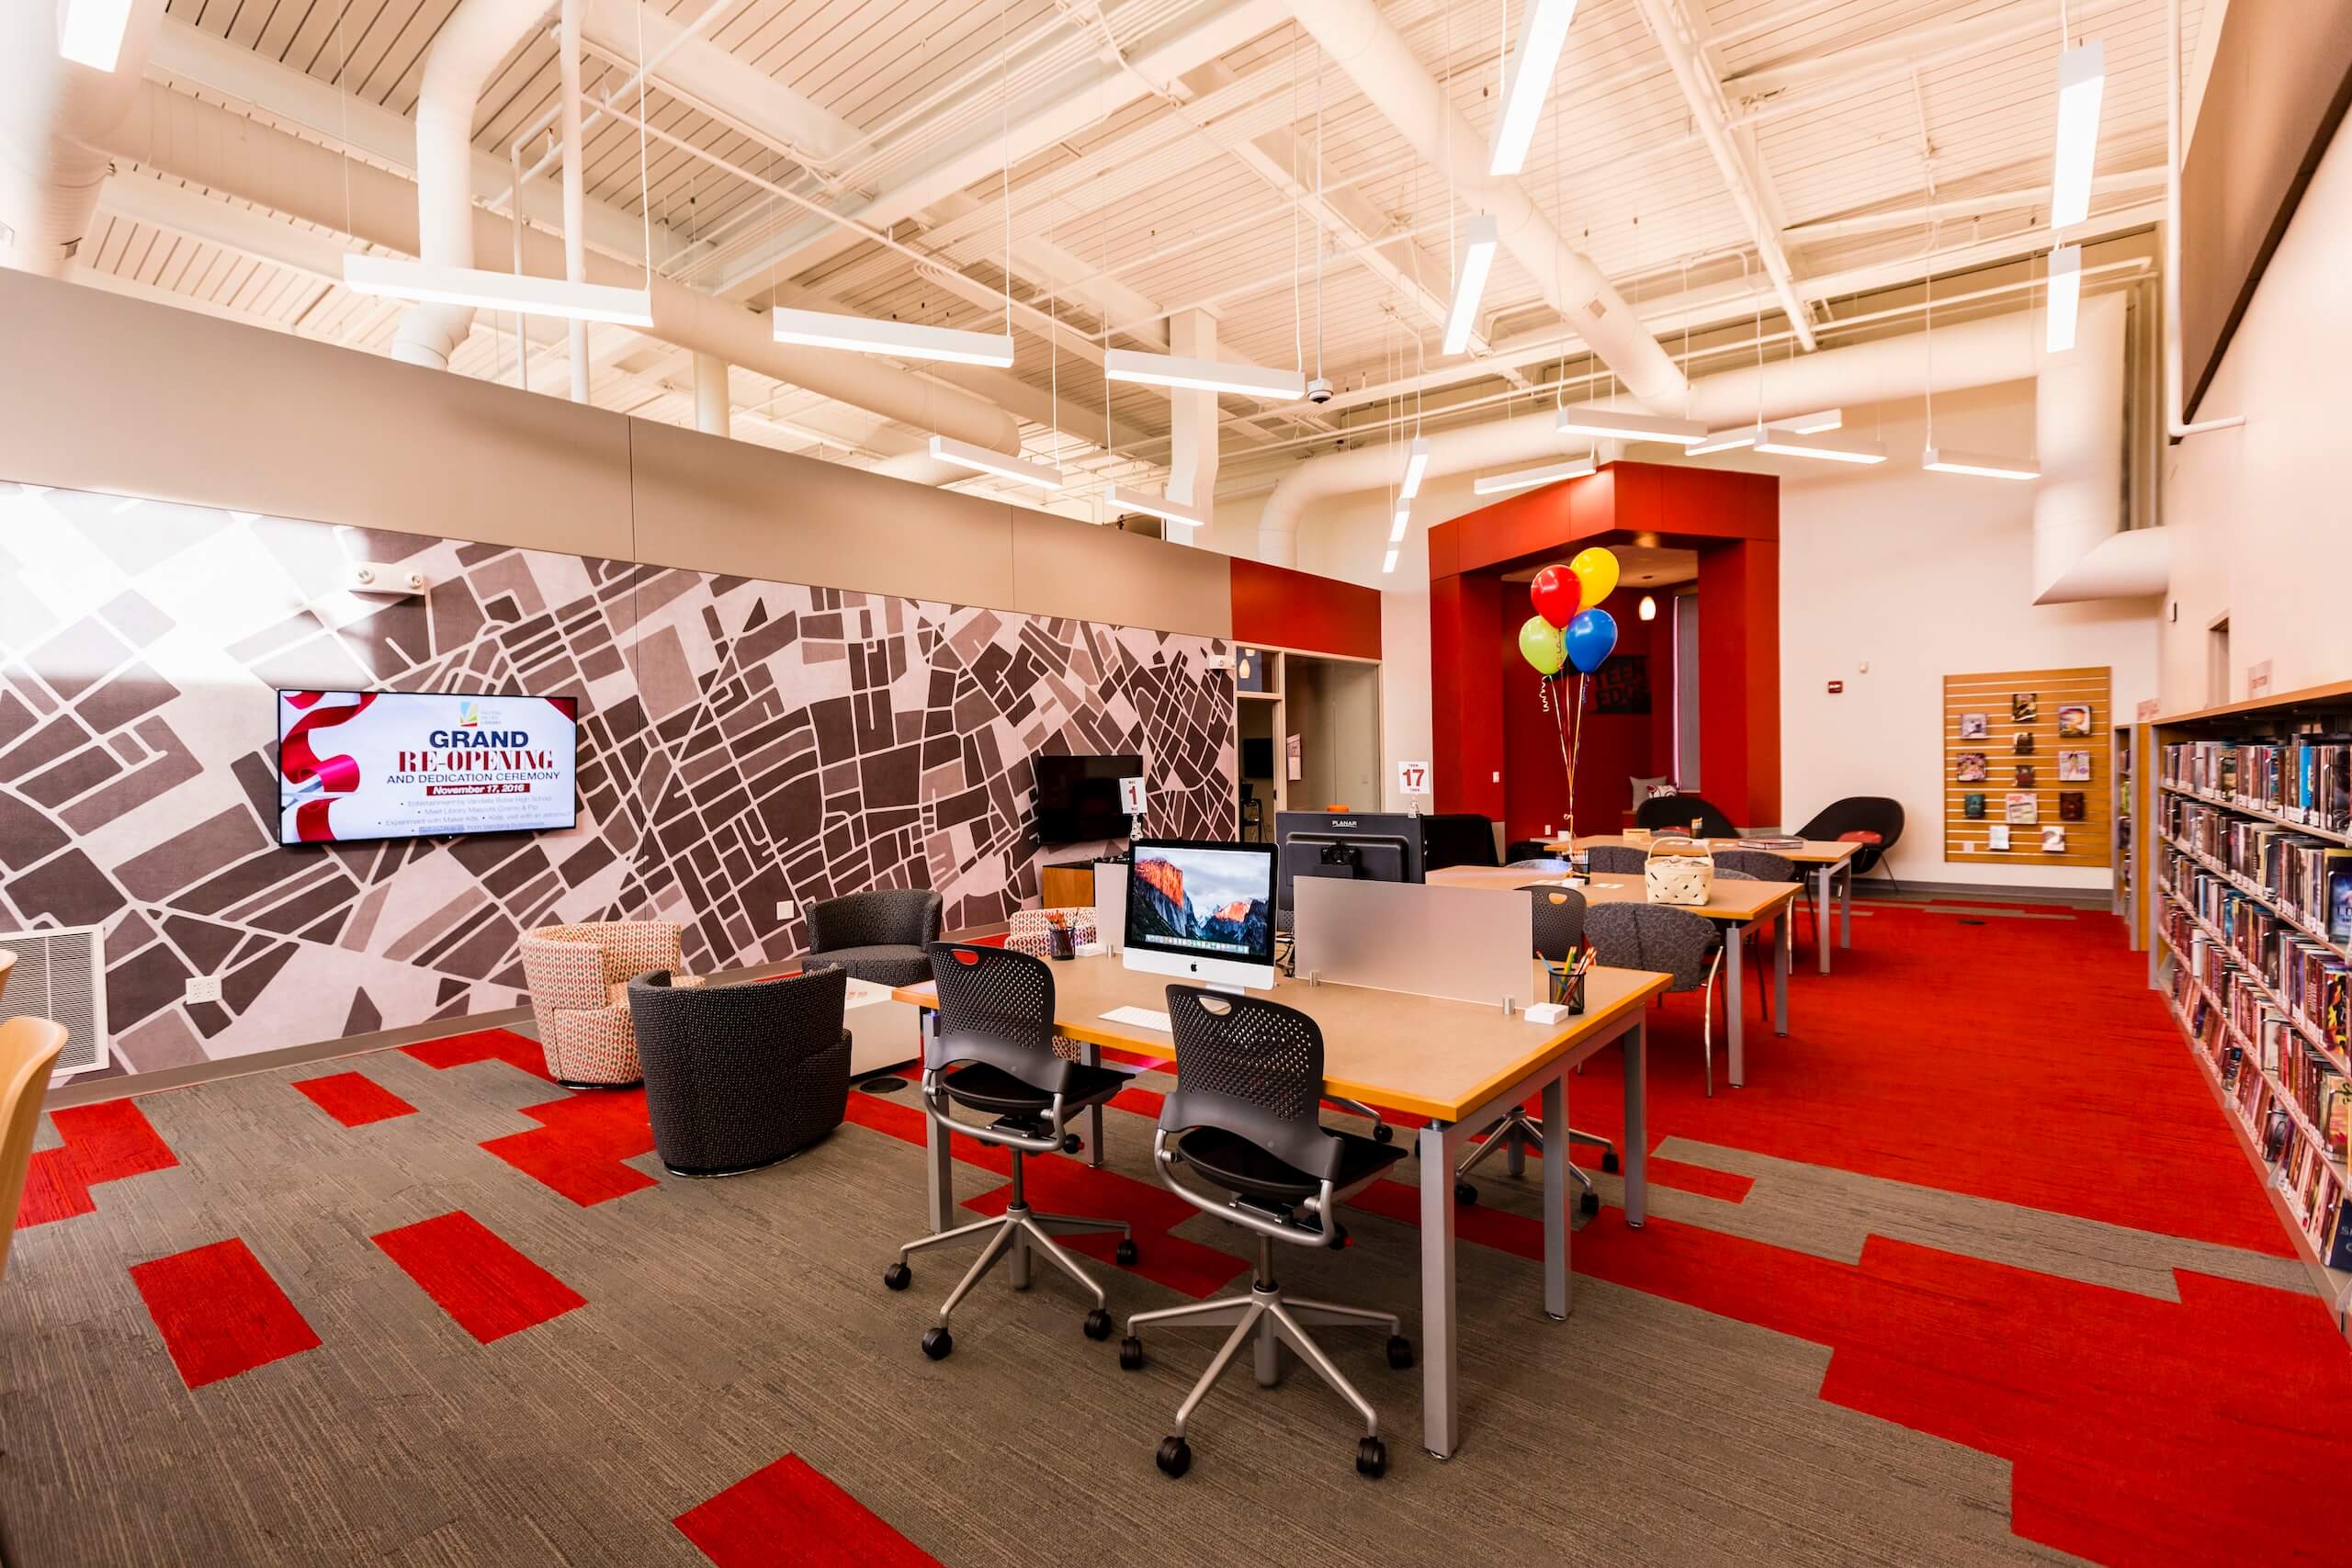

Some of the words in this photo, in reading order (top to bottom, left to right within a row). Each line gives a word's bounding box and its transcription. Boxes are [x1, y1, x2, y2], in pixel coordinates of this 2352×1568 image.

[429, 729, 529, 749] GRAND
[399, 750, 554, 773] RE-OPENING
[386, 774, 415, 784] AND
[418, 773, 493, 784] DEDICATION
[495, 771, 560, 782] CEREMONY
[1403, 769, 1425, 787] 17
[433, 784, 486, 795] November
[487, 784, 500, 795] 17,
[501, 784, 525, 794] 2016
[1128, 785, 1137, 806] 1
